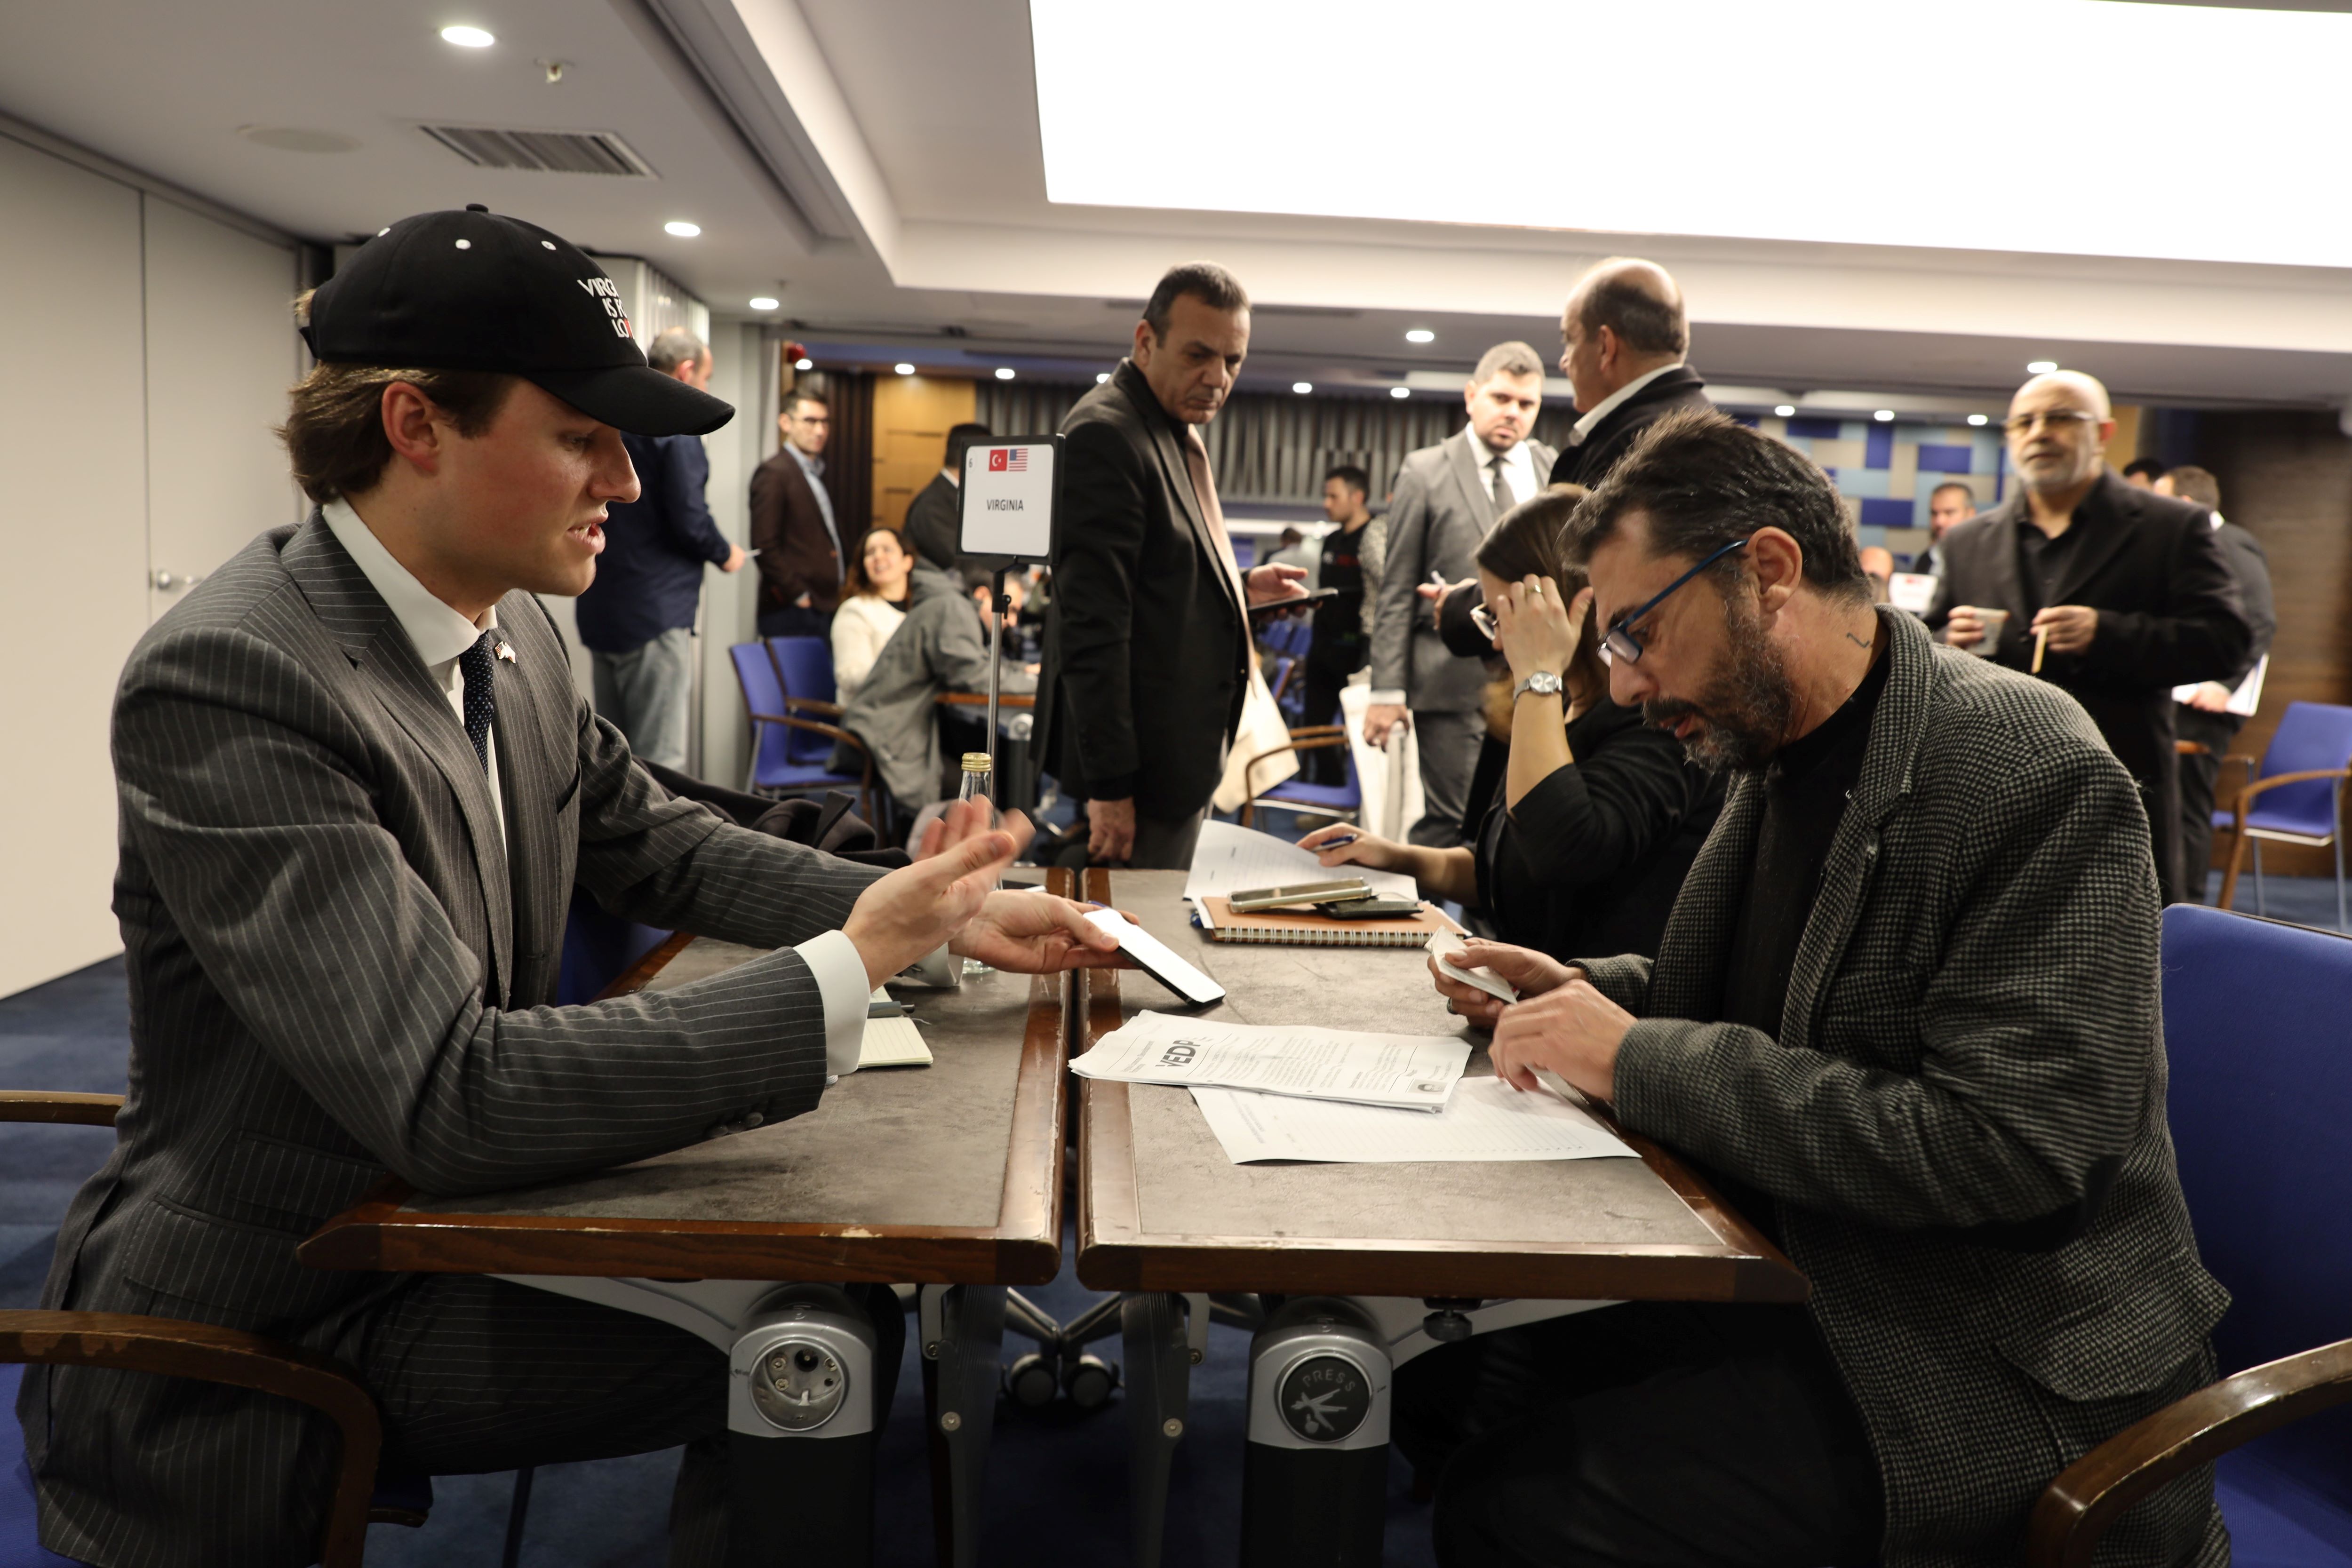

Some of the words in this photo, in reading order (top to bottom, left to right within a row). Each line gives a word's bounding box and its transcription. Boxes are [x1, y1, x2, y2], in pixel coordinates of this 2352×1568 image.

[577, 277, 619, 297] VIRG
[602, 297, 618, 318] IS
[968, 458, 973, 468] 6
[987, 499, 1024, 511] VIRGINIA
[1302, 1368, 1355, 1392] PRESS
